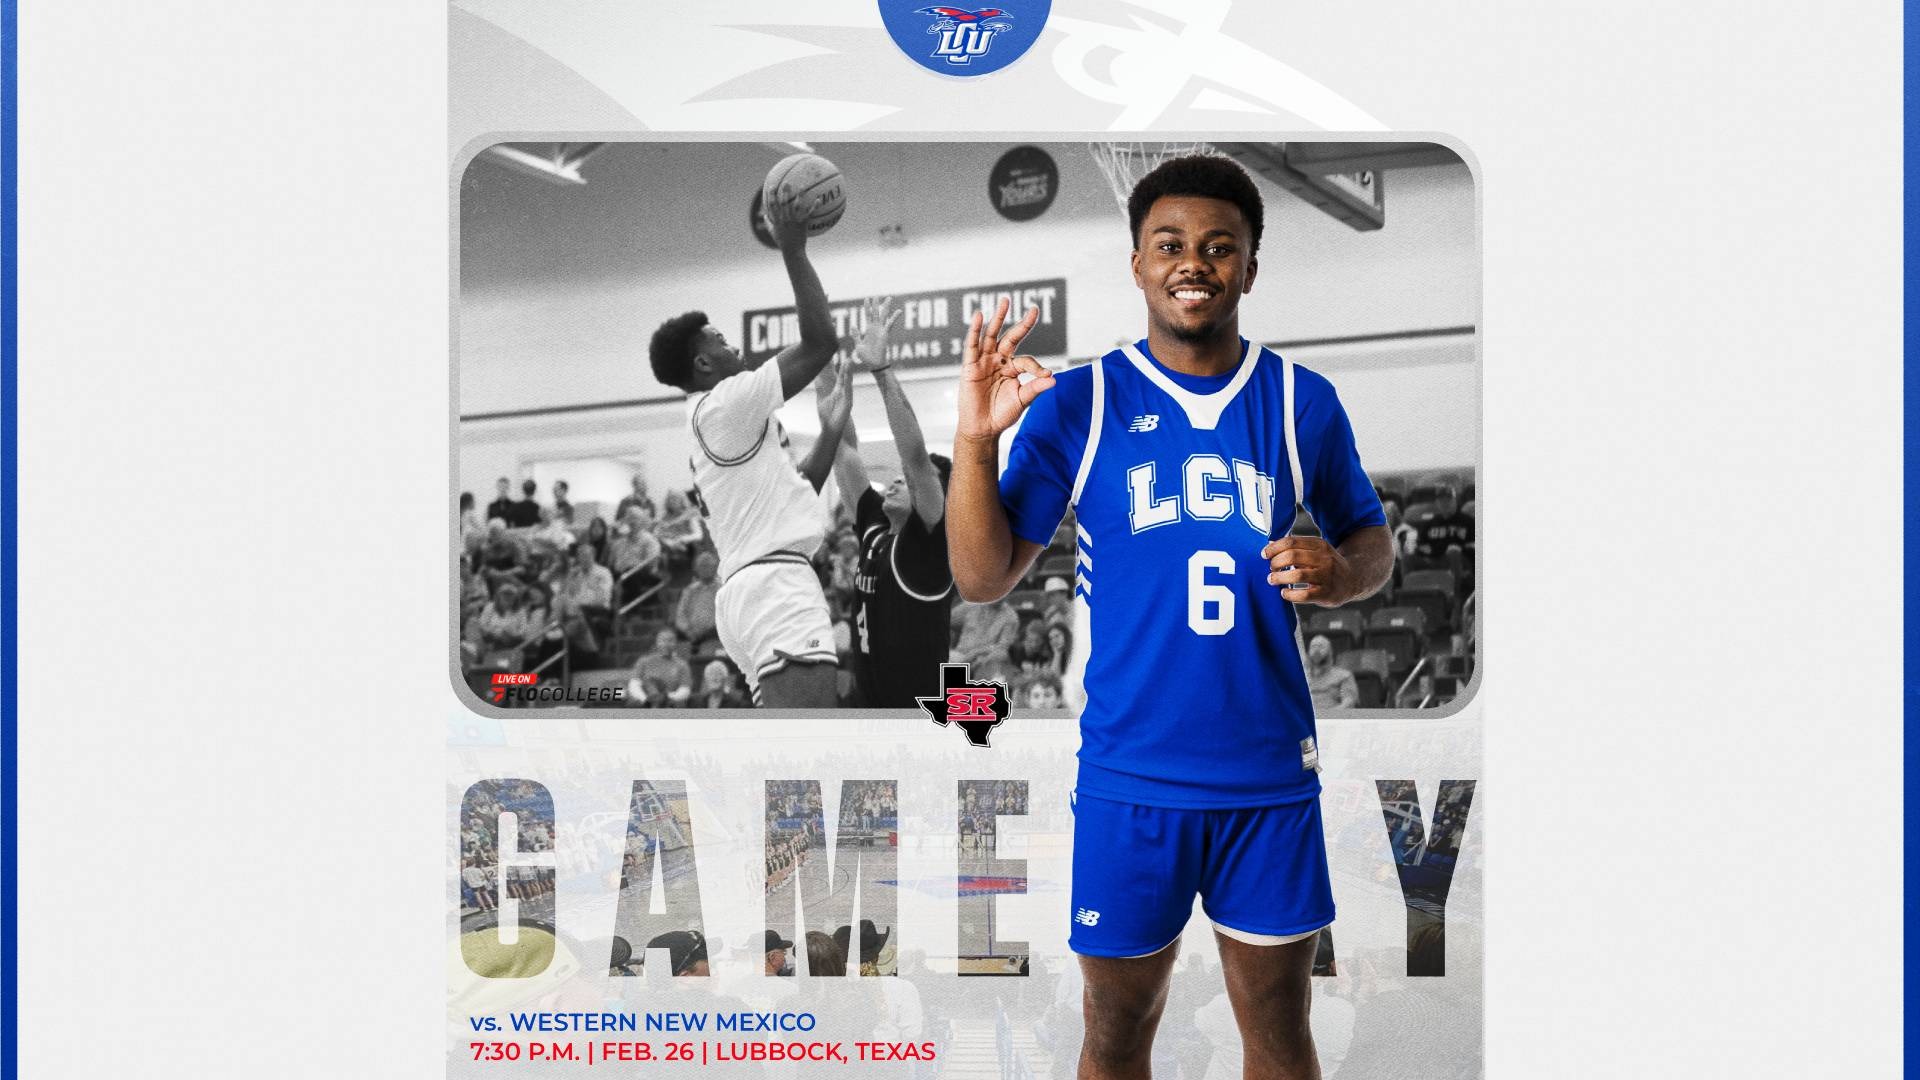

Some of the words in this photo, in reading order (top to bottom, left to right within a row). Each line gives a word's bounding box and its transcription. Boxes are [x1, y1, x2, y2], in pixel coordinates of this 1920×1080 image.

[904, 299, 948, 330] FOR
[1127, 453, 1275, 536] LCU
[1187, 550, 1236, 636] 6
